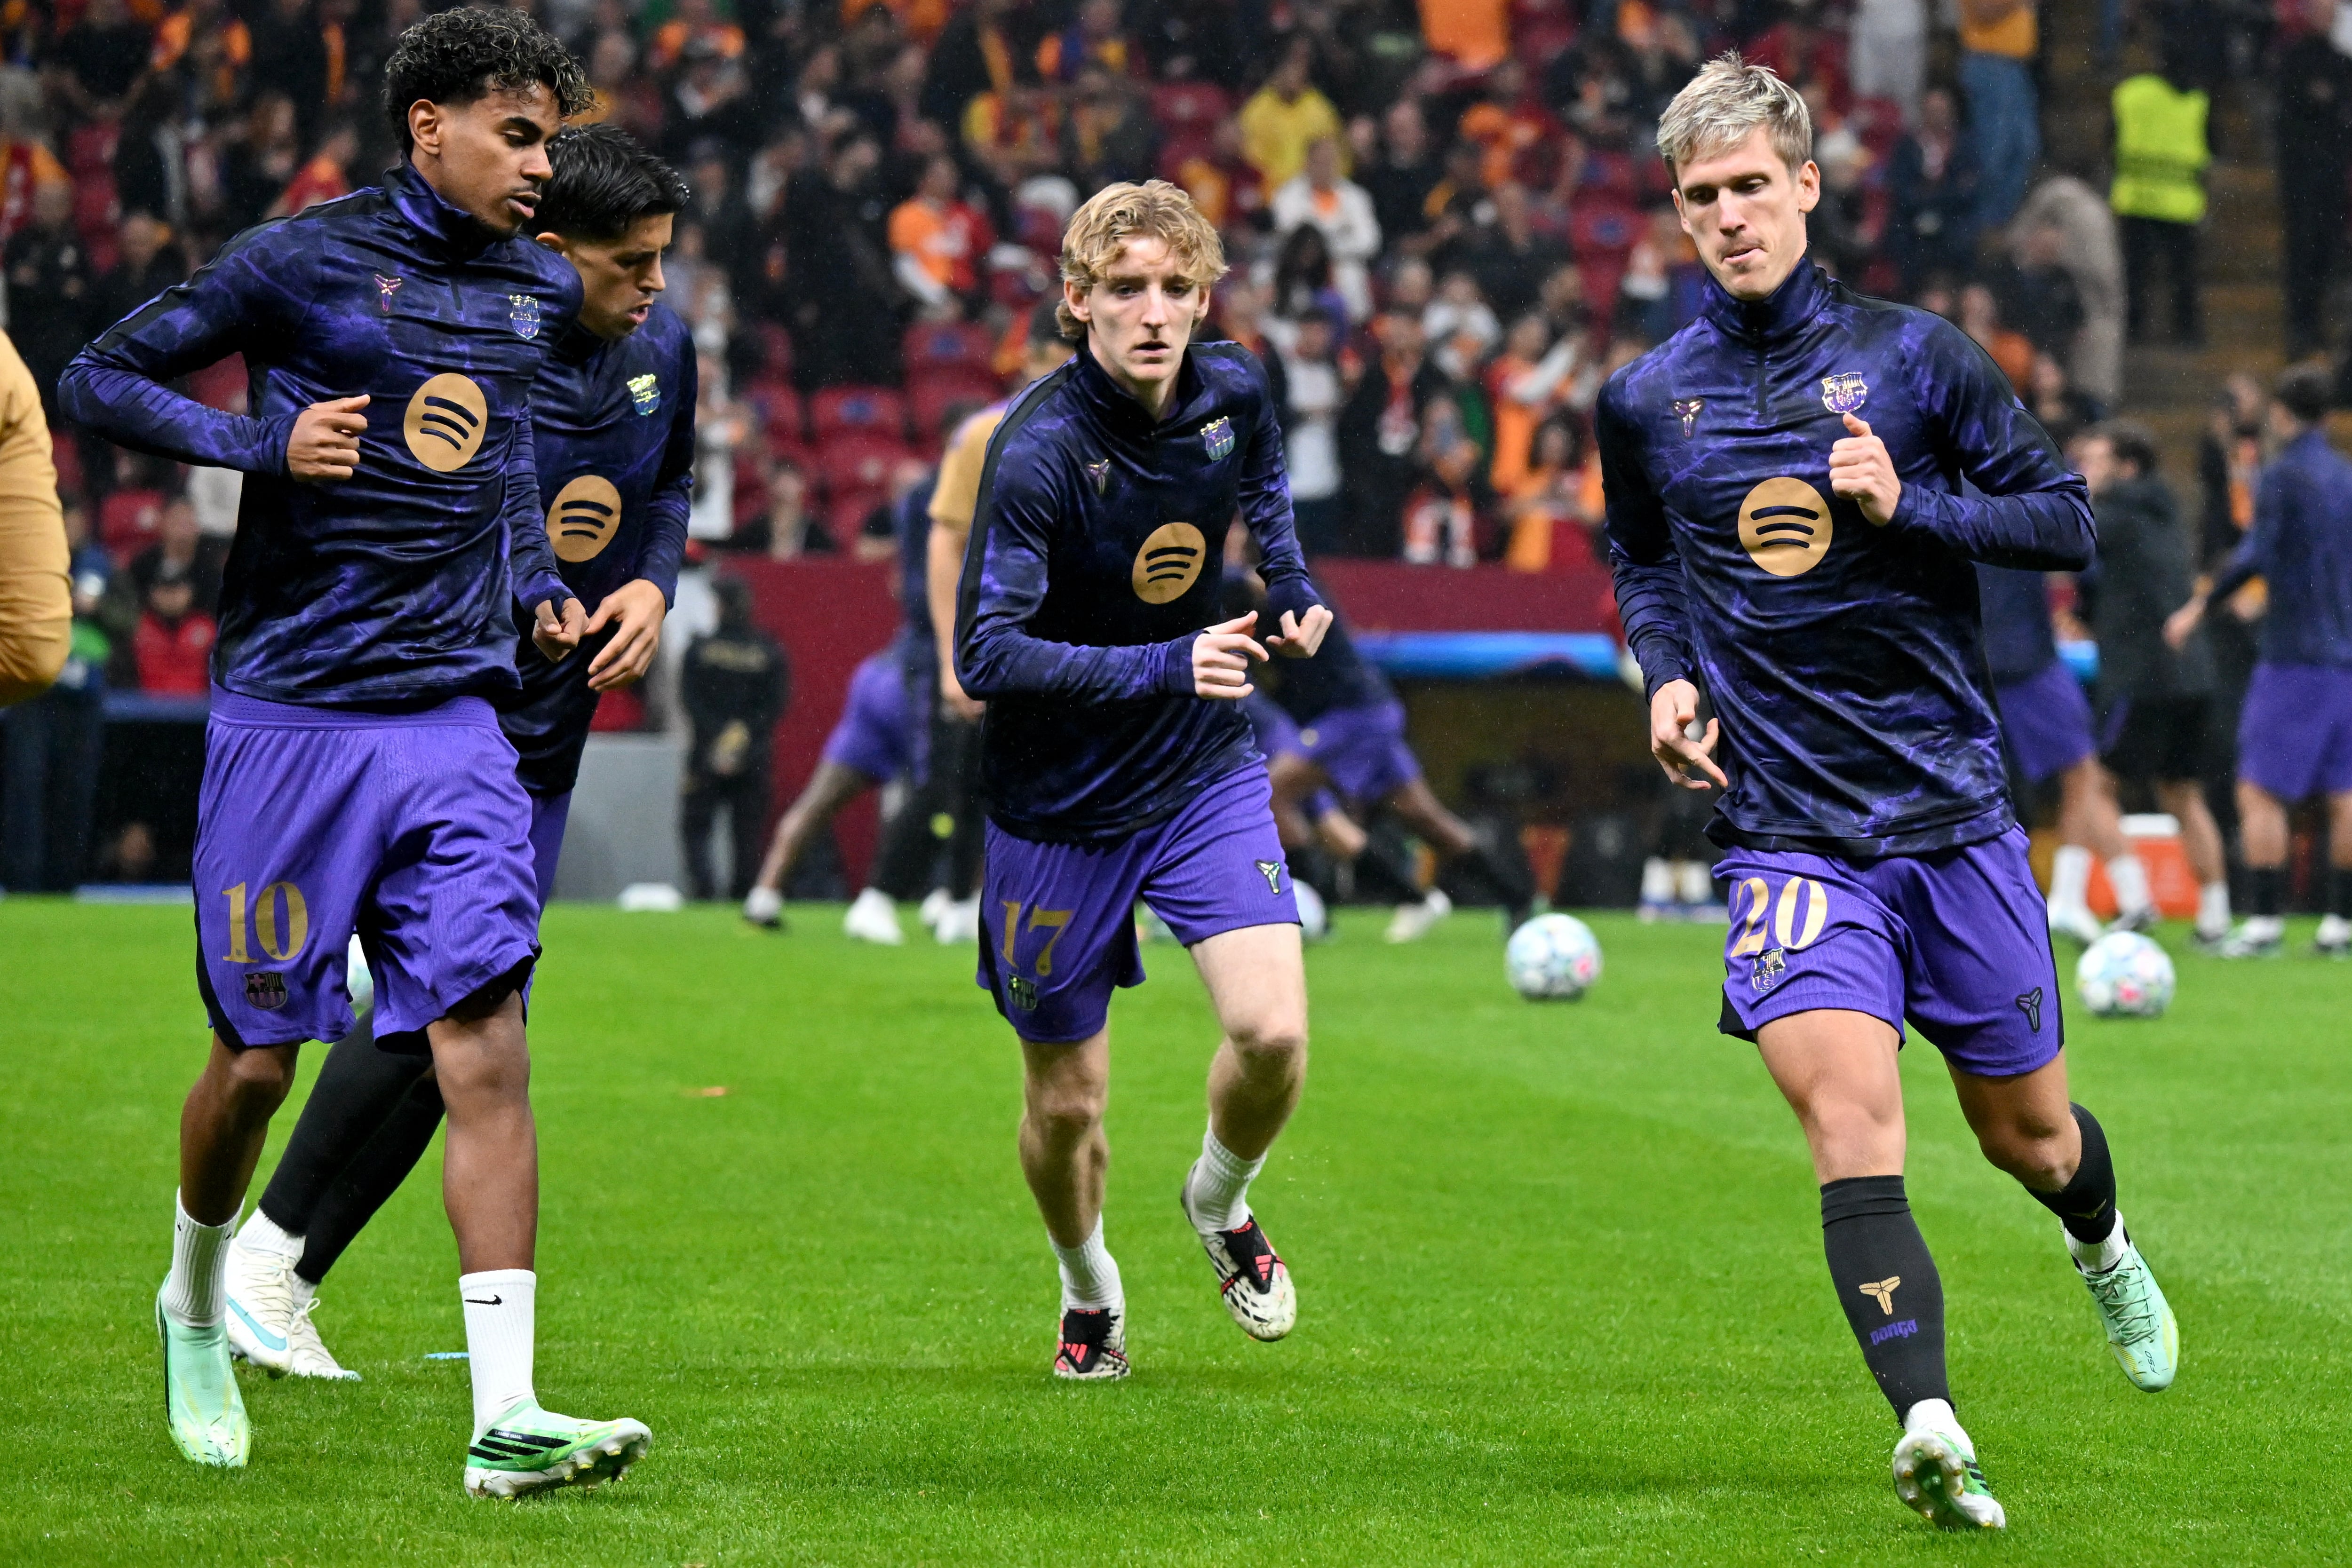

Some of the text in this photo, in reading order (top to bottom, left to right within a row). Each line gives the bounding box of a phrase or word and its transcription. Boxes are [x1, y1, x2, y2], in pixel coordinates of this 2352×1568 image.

[222, 881, 308, 963] 10
[1001, 901, 1074, 976] 17
[1730, 876, 1828, 957] 20
[2145, 1351, 2160, 1375] F50
